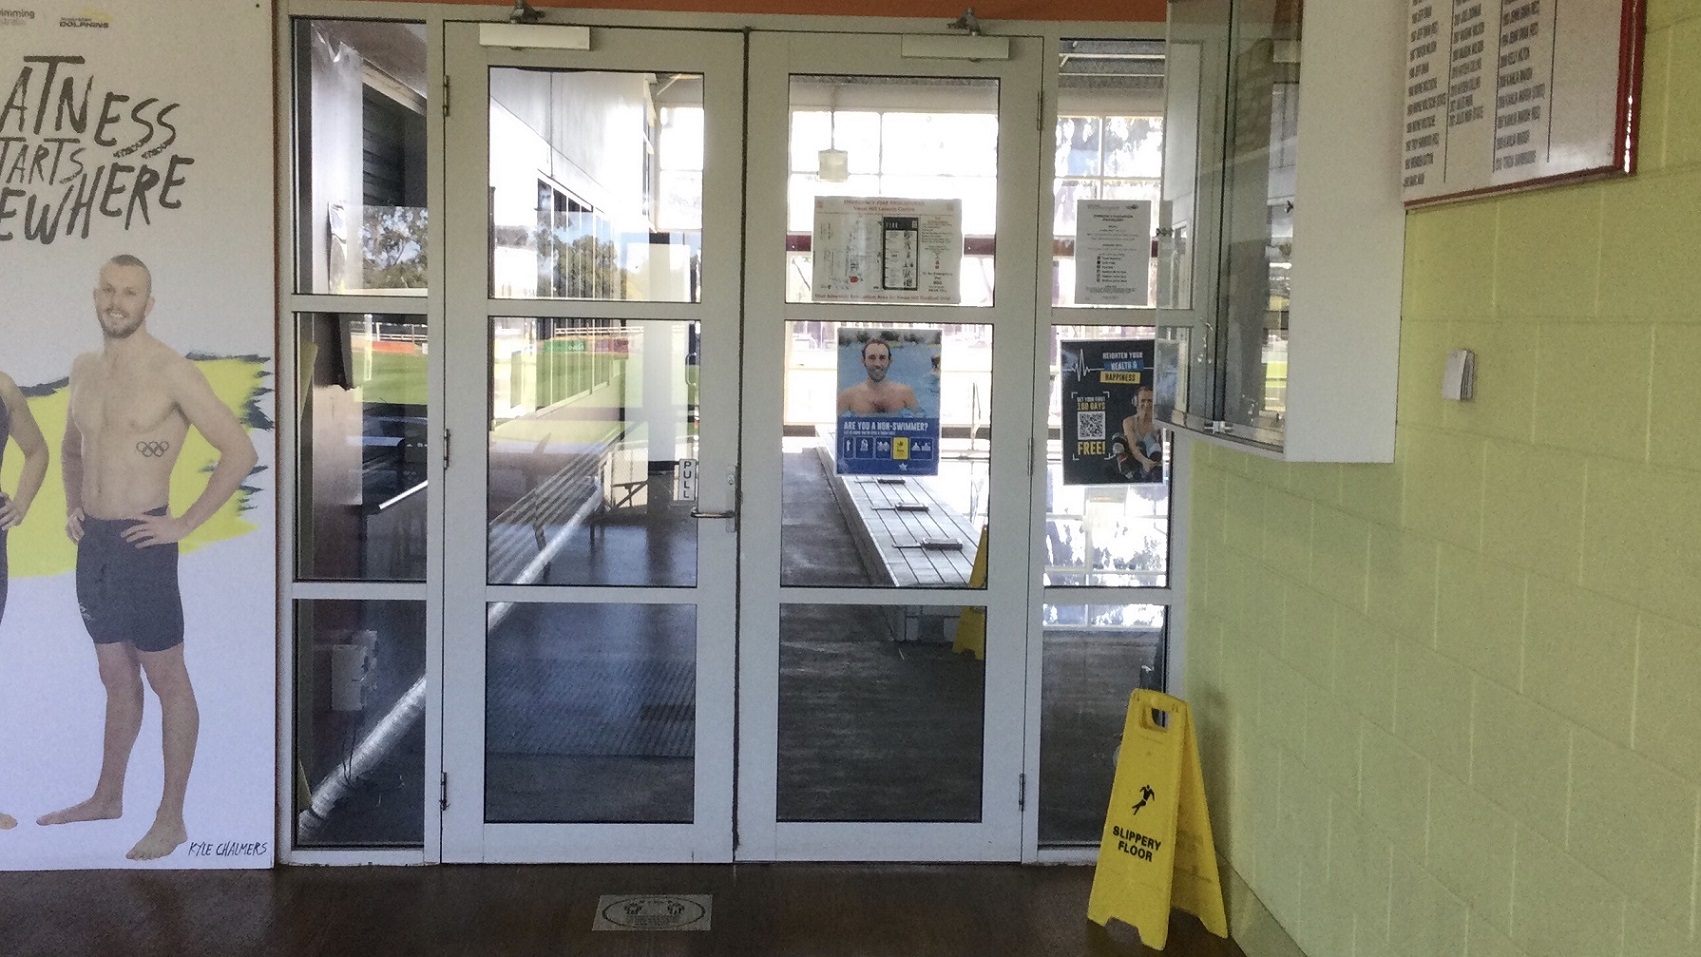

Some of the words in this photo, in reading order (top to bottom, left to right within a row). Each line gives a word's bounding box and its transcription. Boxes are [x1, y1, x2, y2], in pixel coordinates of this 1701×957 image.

[1110, 361, 1132, 371] HEALTH
[1104, 372, 1136, 381] HAPPINESS
[1090, 402, 1106, 410] DAYS
[843, 421, 856, 430] ARE
[858, 421, 870, 430] YOU
[871, 421, 876, 430] A
[877, 422, 929, 431] NON-SWIMMER?
[1077, 441, 1106, 455] FREE!
[683, 461, 692, 498] PULL
[1112, 825, 1162, 851] SLIPPERY
[188, 841, 214, 856] KYLE
[216, 840, 268, 856] CHALMERS
[1117, 841, 1153, 862] FLOOR
